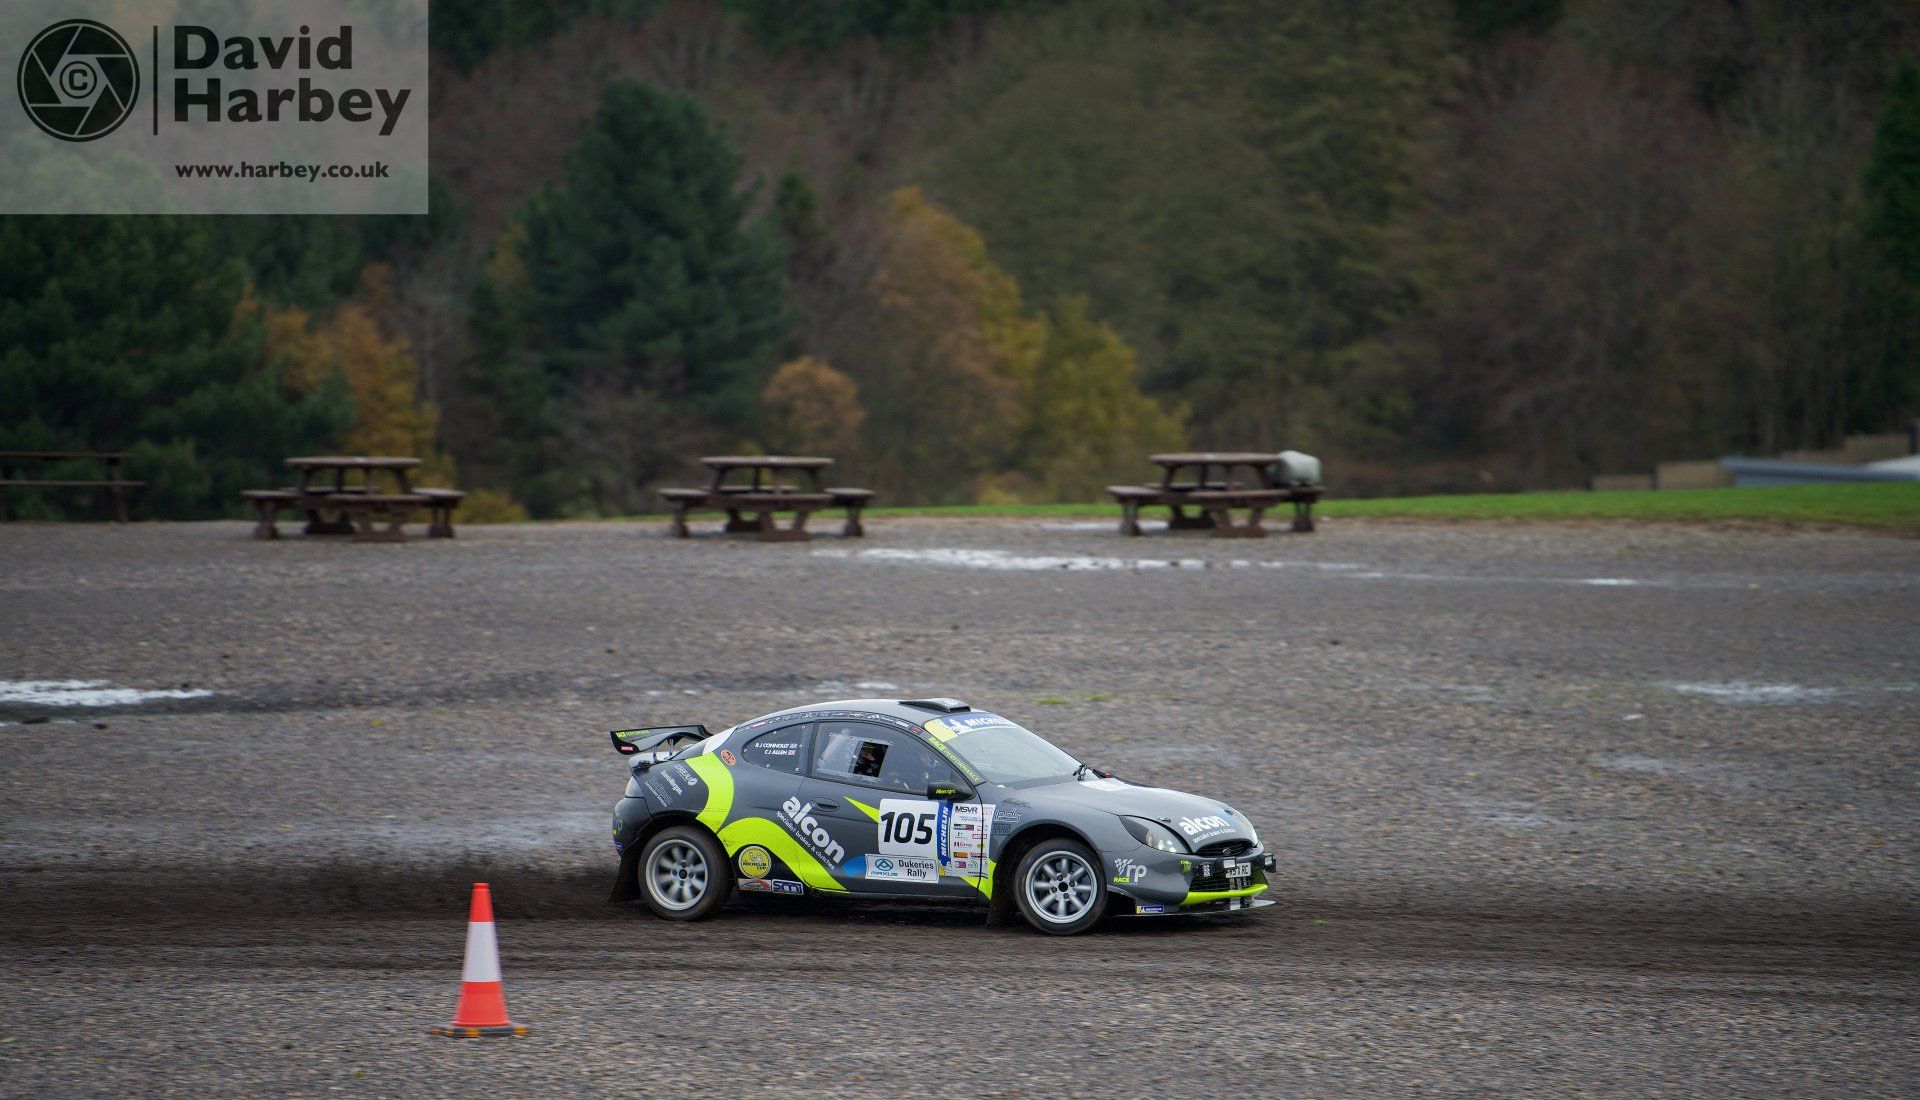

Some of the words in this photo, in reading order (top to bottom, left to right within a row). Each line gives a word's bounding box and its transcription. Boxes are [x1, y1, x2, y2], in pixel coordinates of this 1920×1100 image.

[954, 805, 978, 814] MSVR
[782, 796, 845, 864] alcon
[880, 811, 936, 845] 105
[940, 806, 949, 857] MICHELIN
[1179, 815, 1231, 836] alcon
[776, 810, 797, 833] specialist
[795, 830, 811, 848] brakes
[815, 850, 836, 871] clutches
[898, 860, 934, 869] Dukeries
[907, 869, 927, 879] Rally
